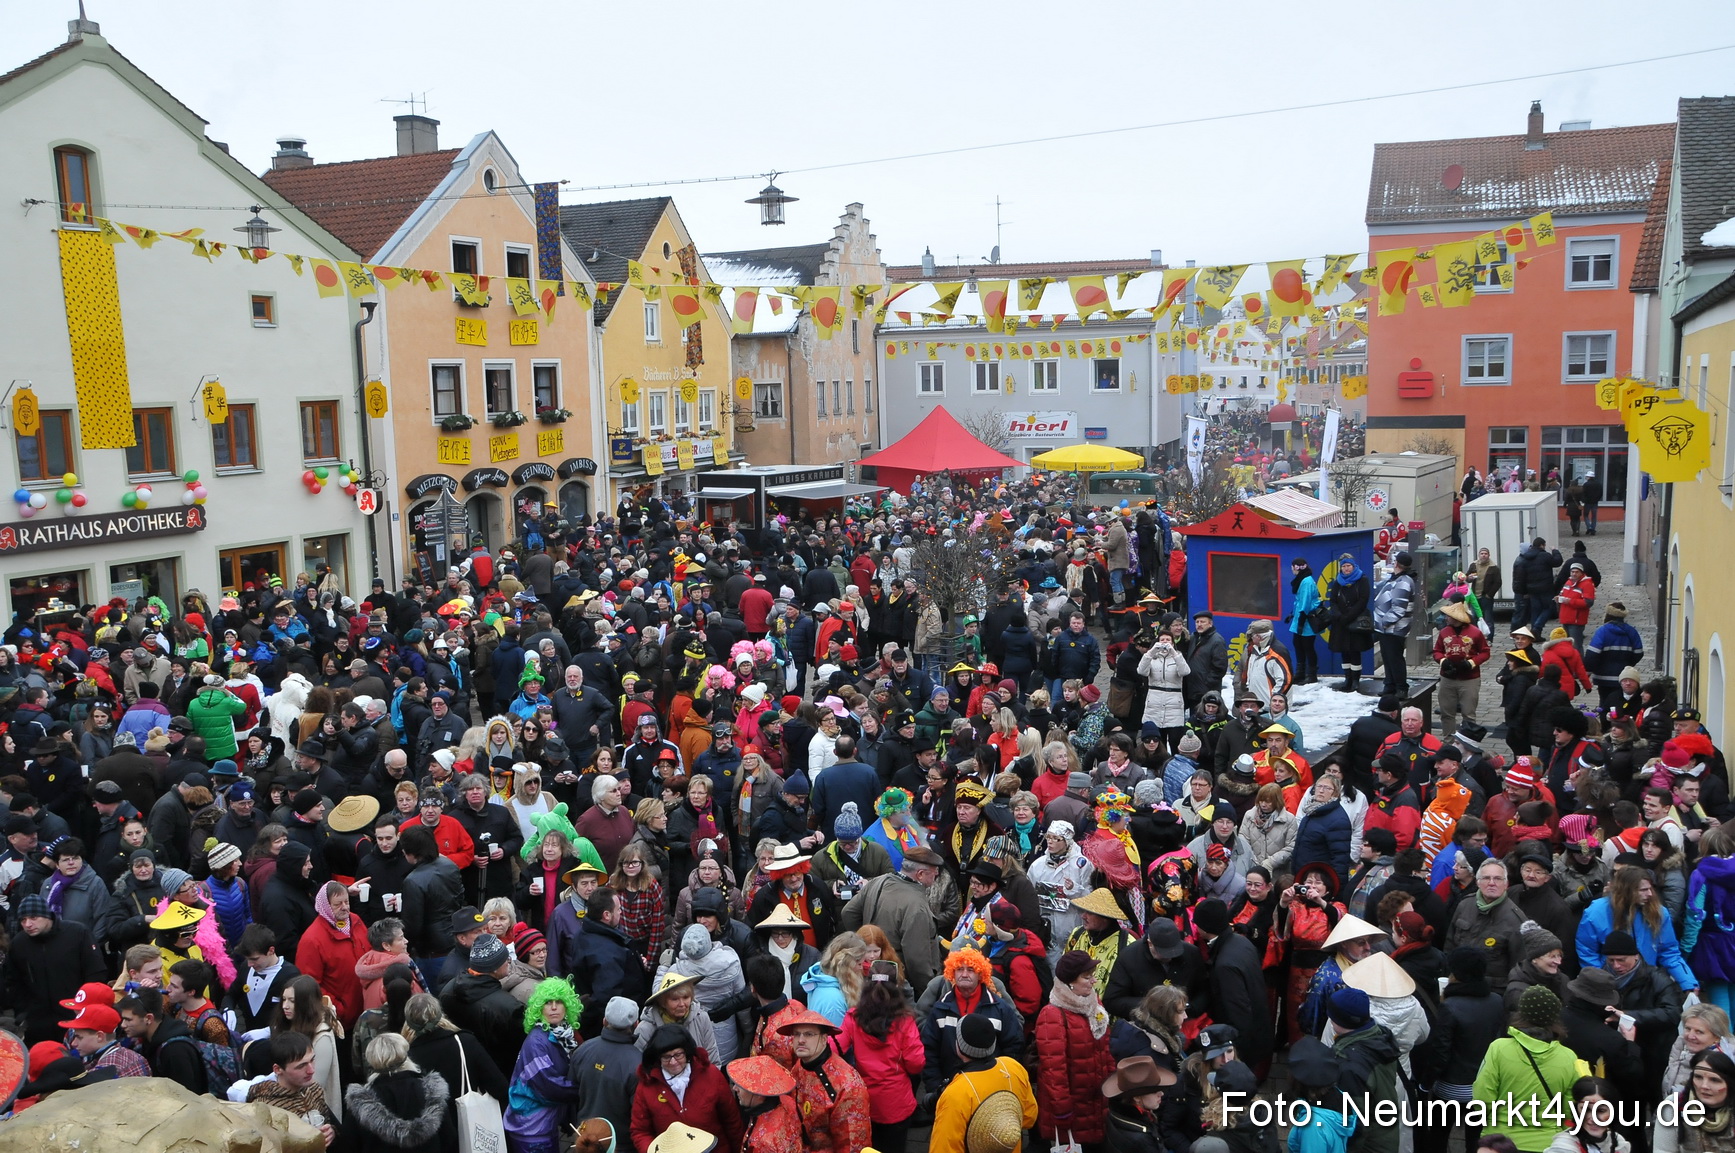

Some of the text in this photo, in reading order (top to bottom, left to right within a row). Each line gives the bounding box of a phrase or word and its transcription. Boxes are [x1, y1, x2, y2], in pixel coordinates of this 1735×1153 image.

[1009, 419, 1069, 432] hierl
[570, 459, 594, 473] IMBISS
[521, 464, 555, 483] FEINKOST
[775, 473, 805, 484] IMBISS
[20, 520, 103, 546] RATHAUS
[106, 512, 184, 536] APOTHEKE
